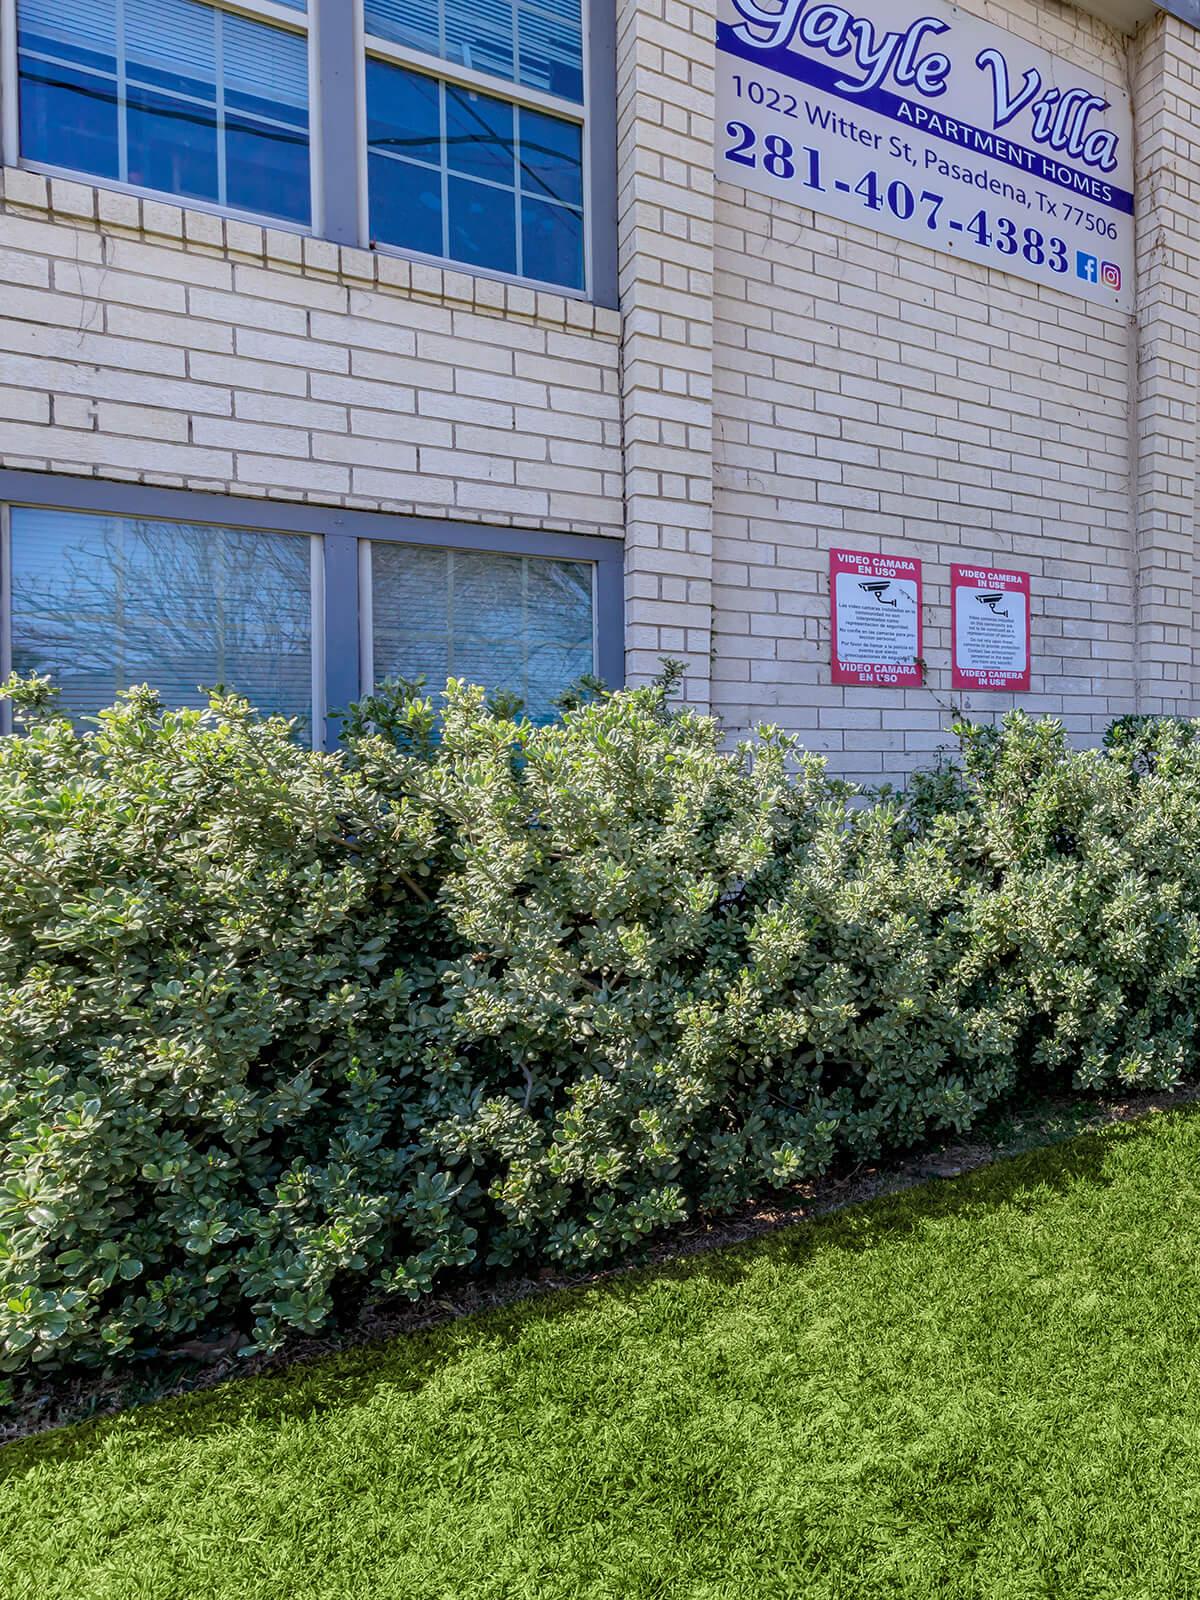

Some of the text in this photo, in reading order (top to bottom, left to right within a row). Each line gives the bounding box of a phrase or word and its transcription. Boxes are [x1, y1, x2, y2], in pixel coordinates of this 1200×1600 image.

[976, 48, 1120, 173] Villa
[732, 75, 1118, 240] 1022 Witter St, Pasadena, Tx 77506
[897, 102, 1112, 202] APARTMENT HOMES
[724, 120, 1069, 274] 281-407-4383
[837, 554, 915, 571] VIDEO CAMARA
[858, 566, 896, 578] EN USO
[958, 569, 1023, 584] VIDEO CAMERA
[977, 580, 1005, 590] IN USE
[839, 663, 917, 675] VIDEO CAMARA
[960, 669, 1023, 680] VIDEO CAMERA
[859, 674, 897, 683] EN USO
[978, 678, 1006, 687] IN USE
